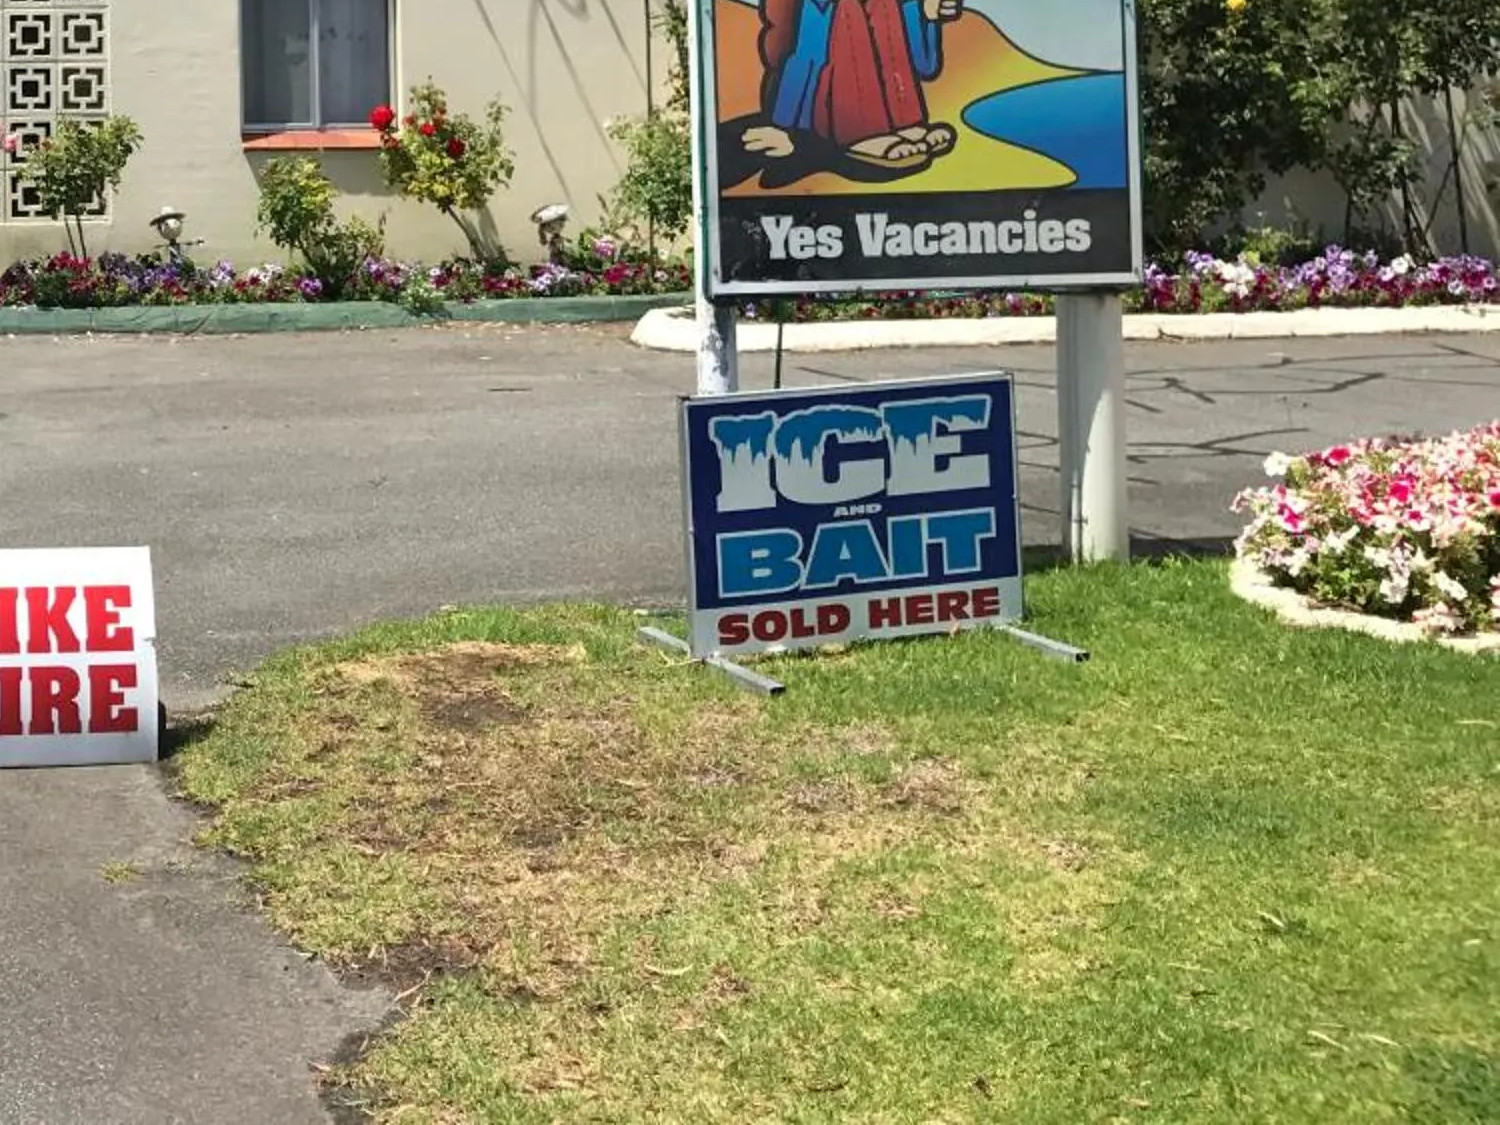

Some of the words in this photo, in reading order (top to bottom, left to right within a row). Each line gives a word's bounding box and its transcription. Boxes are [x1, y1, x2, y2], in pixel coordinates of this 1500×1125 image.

[760, 215, 843, 261] Yes
[855, 209, 1092, 258] Vacancies
[712, 395, 992, 512] ICE
[833, 503, 883, 518] AND
[718, 508, 996, 598] BAIT
[717, 603, 851, 646] SOLD
[868, 587, 1001, 629] HERE
